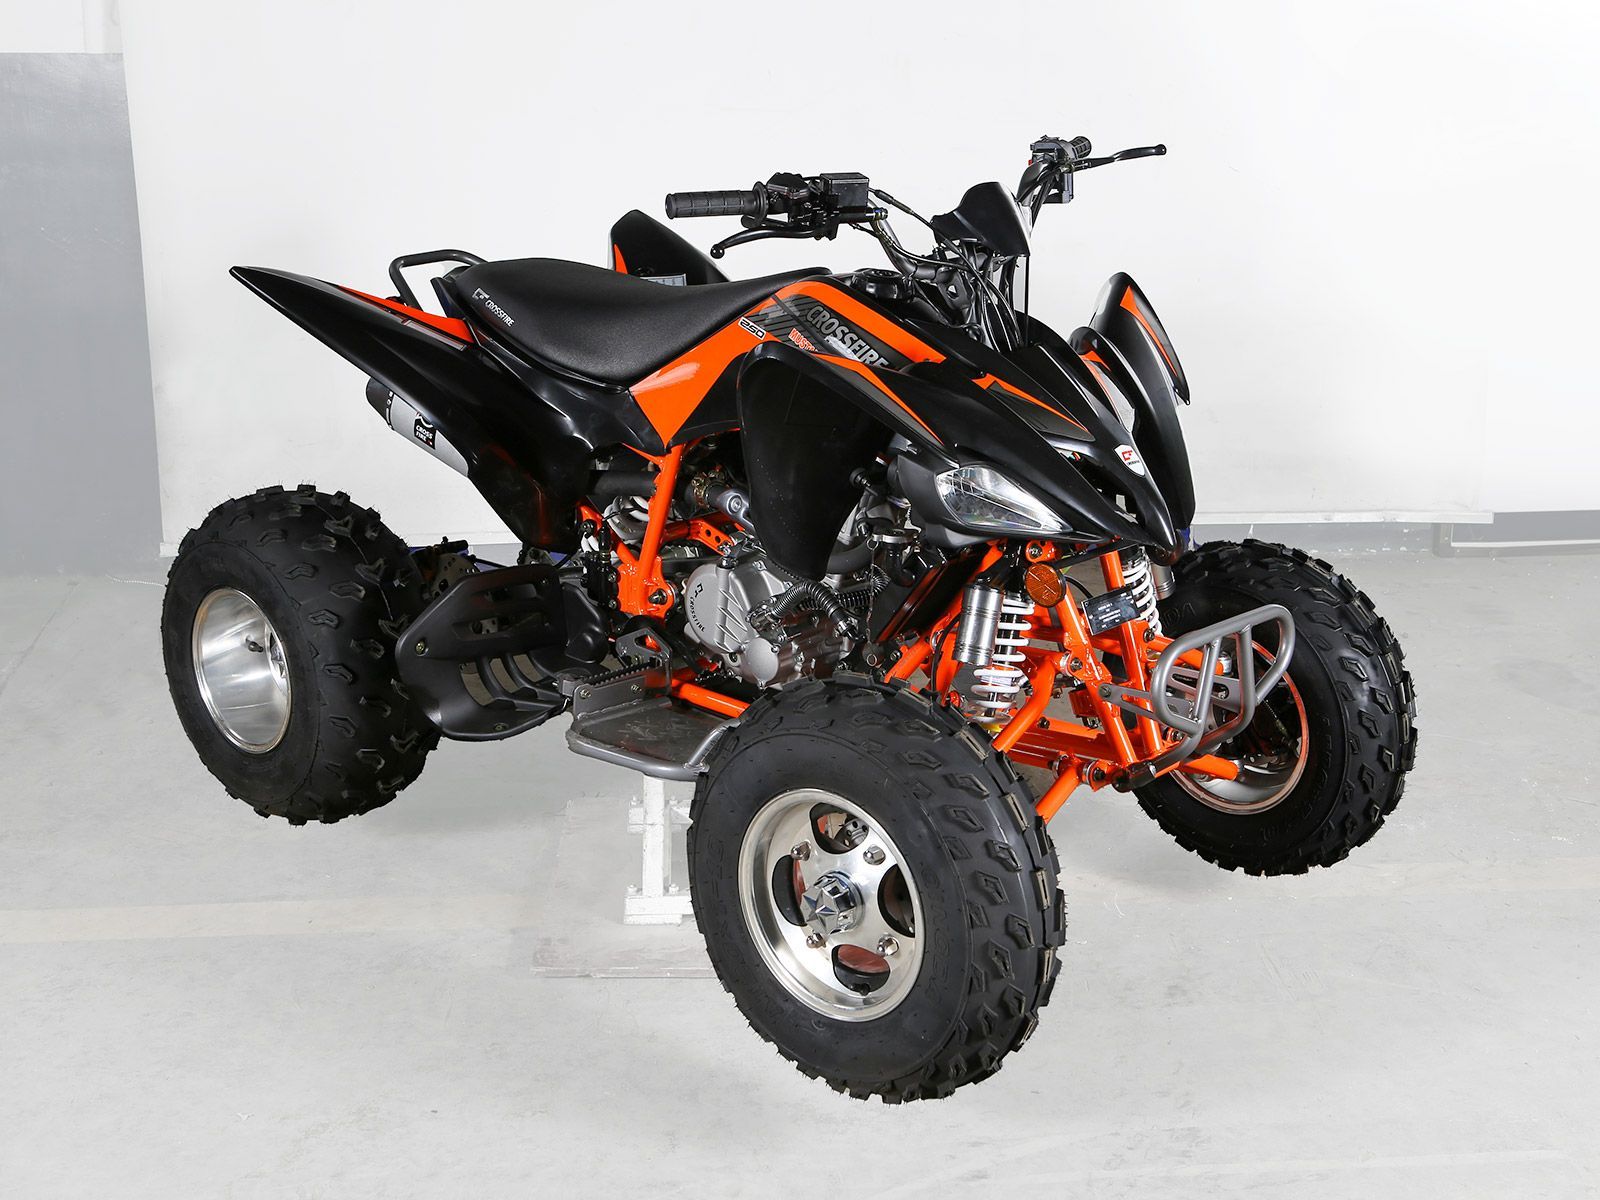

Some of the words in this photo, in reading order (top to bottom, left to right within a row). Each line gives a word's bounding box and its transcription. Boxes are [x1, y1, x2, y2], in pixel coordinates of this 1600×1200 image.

[485, 300, 515, 327] CROSSFIRE
[739, 319, 765, 338] 250
[415, 425, 433, 439] CROSS
[415, 432, 427, 441] FIRE
